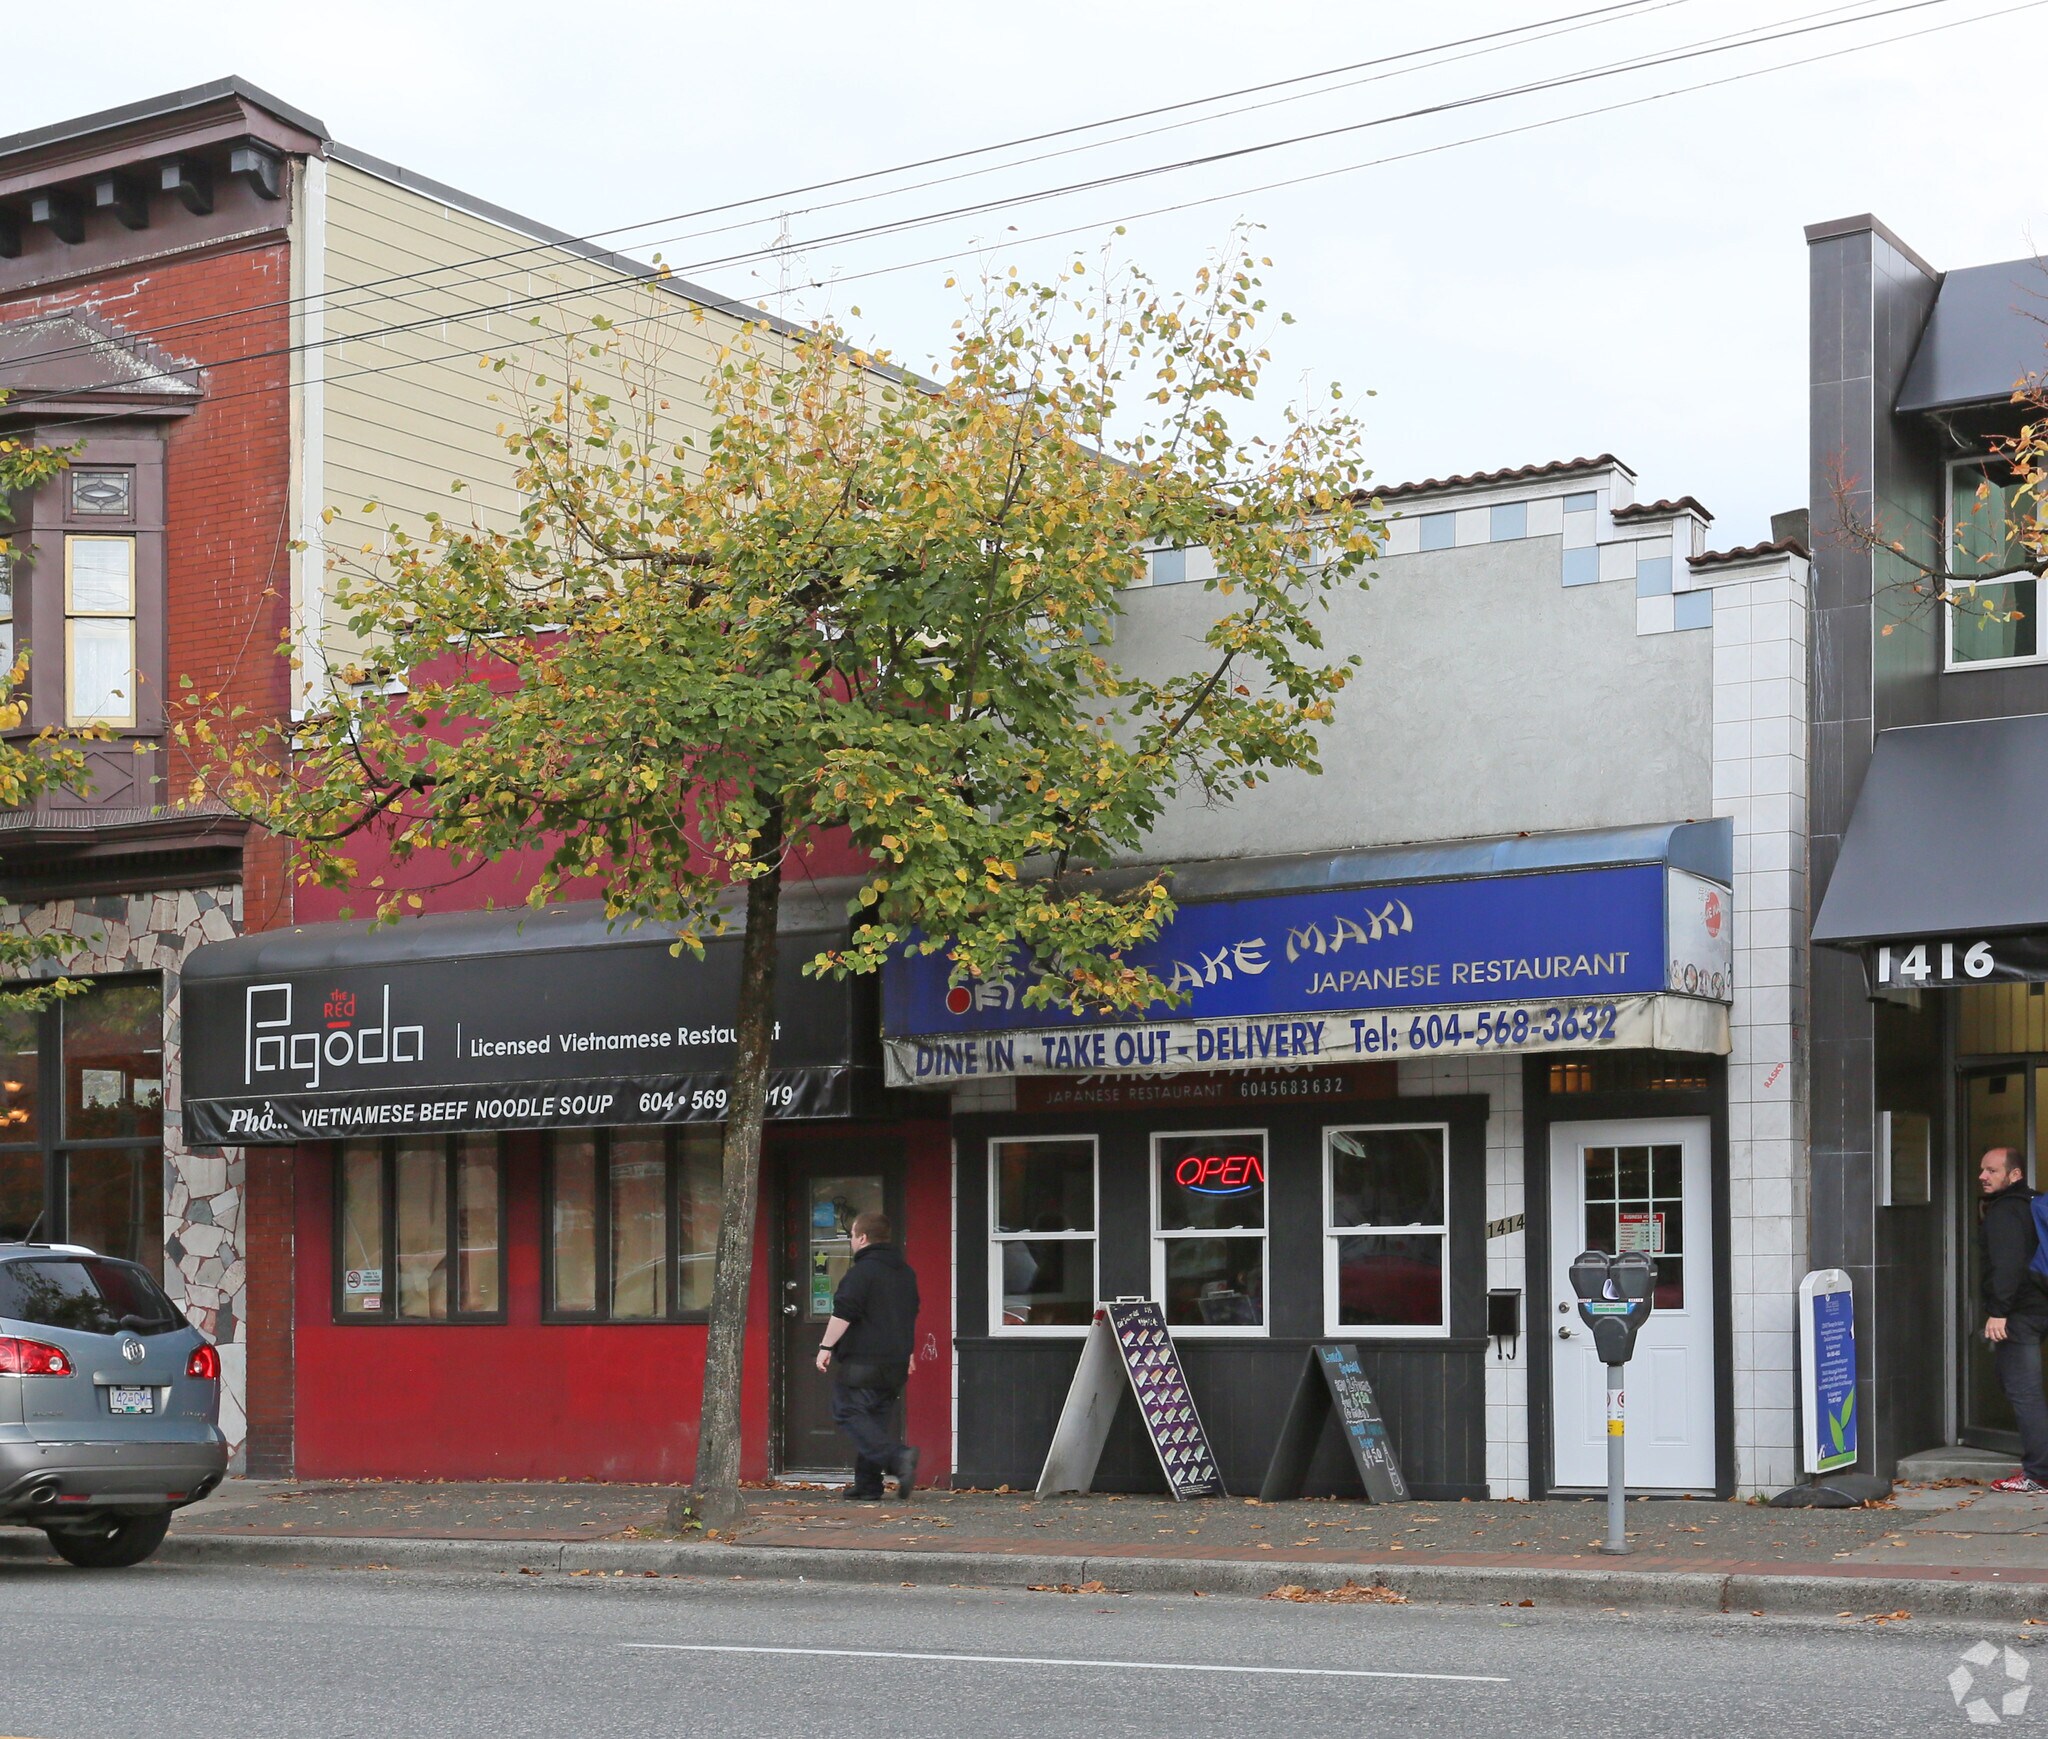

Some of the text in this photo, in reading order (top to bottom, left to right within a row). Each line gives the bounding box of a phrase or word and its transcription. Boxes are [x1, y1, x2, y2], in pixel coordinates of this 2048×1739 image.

[1285, 898, 1413, 964] MAKI
[1305, 951, 1631, 995] JAPANESE RESTAURANT
[1877, 940, 1995, 983] 1416
[244, 982, 424, 1089] Pagoda
[470, 1020, 782, 1058] Licensed Vietnamese Restaut
[915, 1040, 978, 1077] DINE
[985, 1038, 1015, 1073] IN
[1041, 1032, 1106, 1069] TAKE
[1114, 1030, 1171, 1067] OUT
[1195, 1020, 1326, 1062] DELIVERY
[1349, 1018, 1398, 1054] Tel:
[1408, 1002, 1617, 1050] 604-568-3632
[301, 1103, 415, 1128] VIETNAMESE
[418, 1100, 469, 1122] BEEF
[474, 1096, 556, 1120] NOODLE
[558, 1093, 614, 1116] SOUP
[1045, 1077, 1344, 1104] JAPANESE RESTAURANT 6045683632
[1175, 1154, 1265, 1186] OPEN
[1488, 1213, 1526, 1239] 1414
